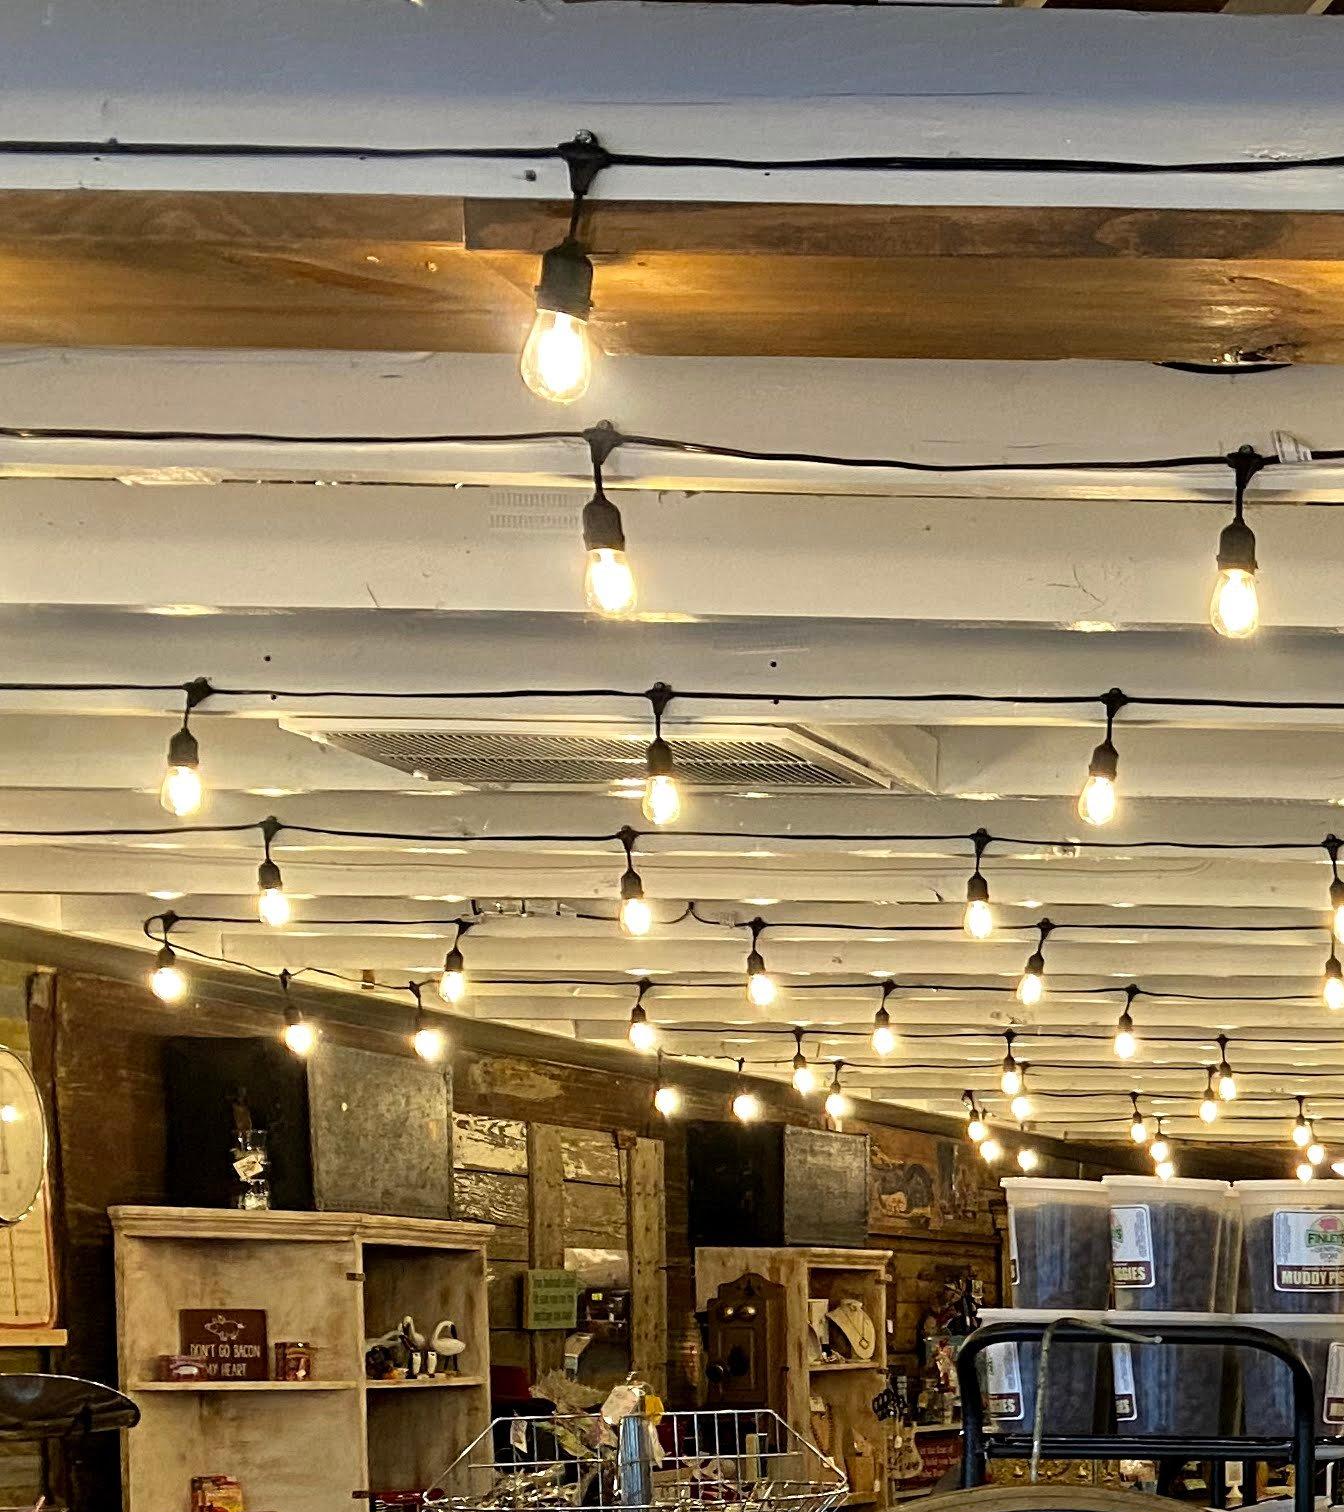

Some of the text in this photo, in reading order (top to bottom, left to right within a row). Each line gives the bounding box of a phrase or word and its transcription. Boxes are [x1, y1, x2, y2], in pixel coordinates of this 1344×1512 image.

[1280, 1270, 1326, 1286] MUDDY
[218, 1344, 231, 1358] GO
[233, 1344, 262, 1358] BACON
[220, 1362, 247, 1377] HEART
